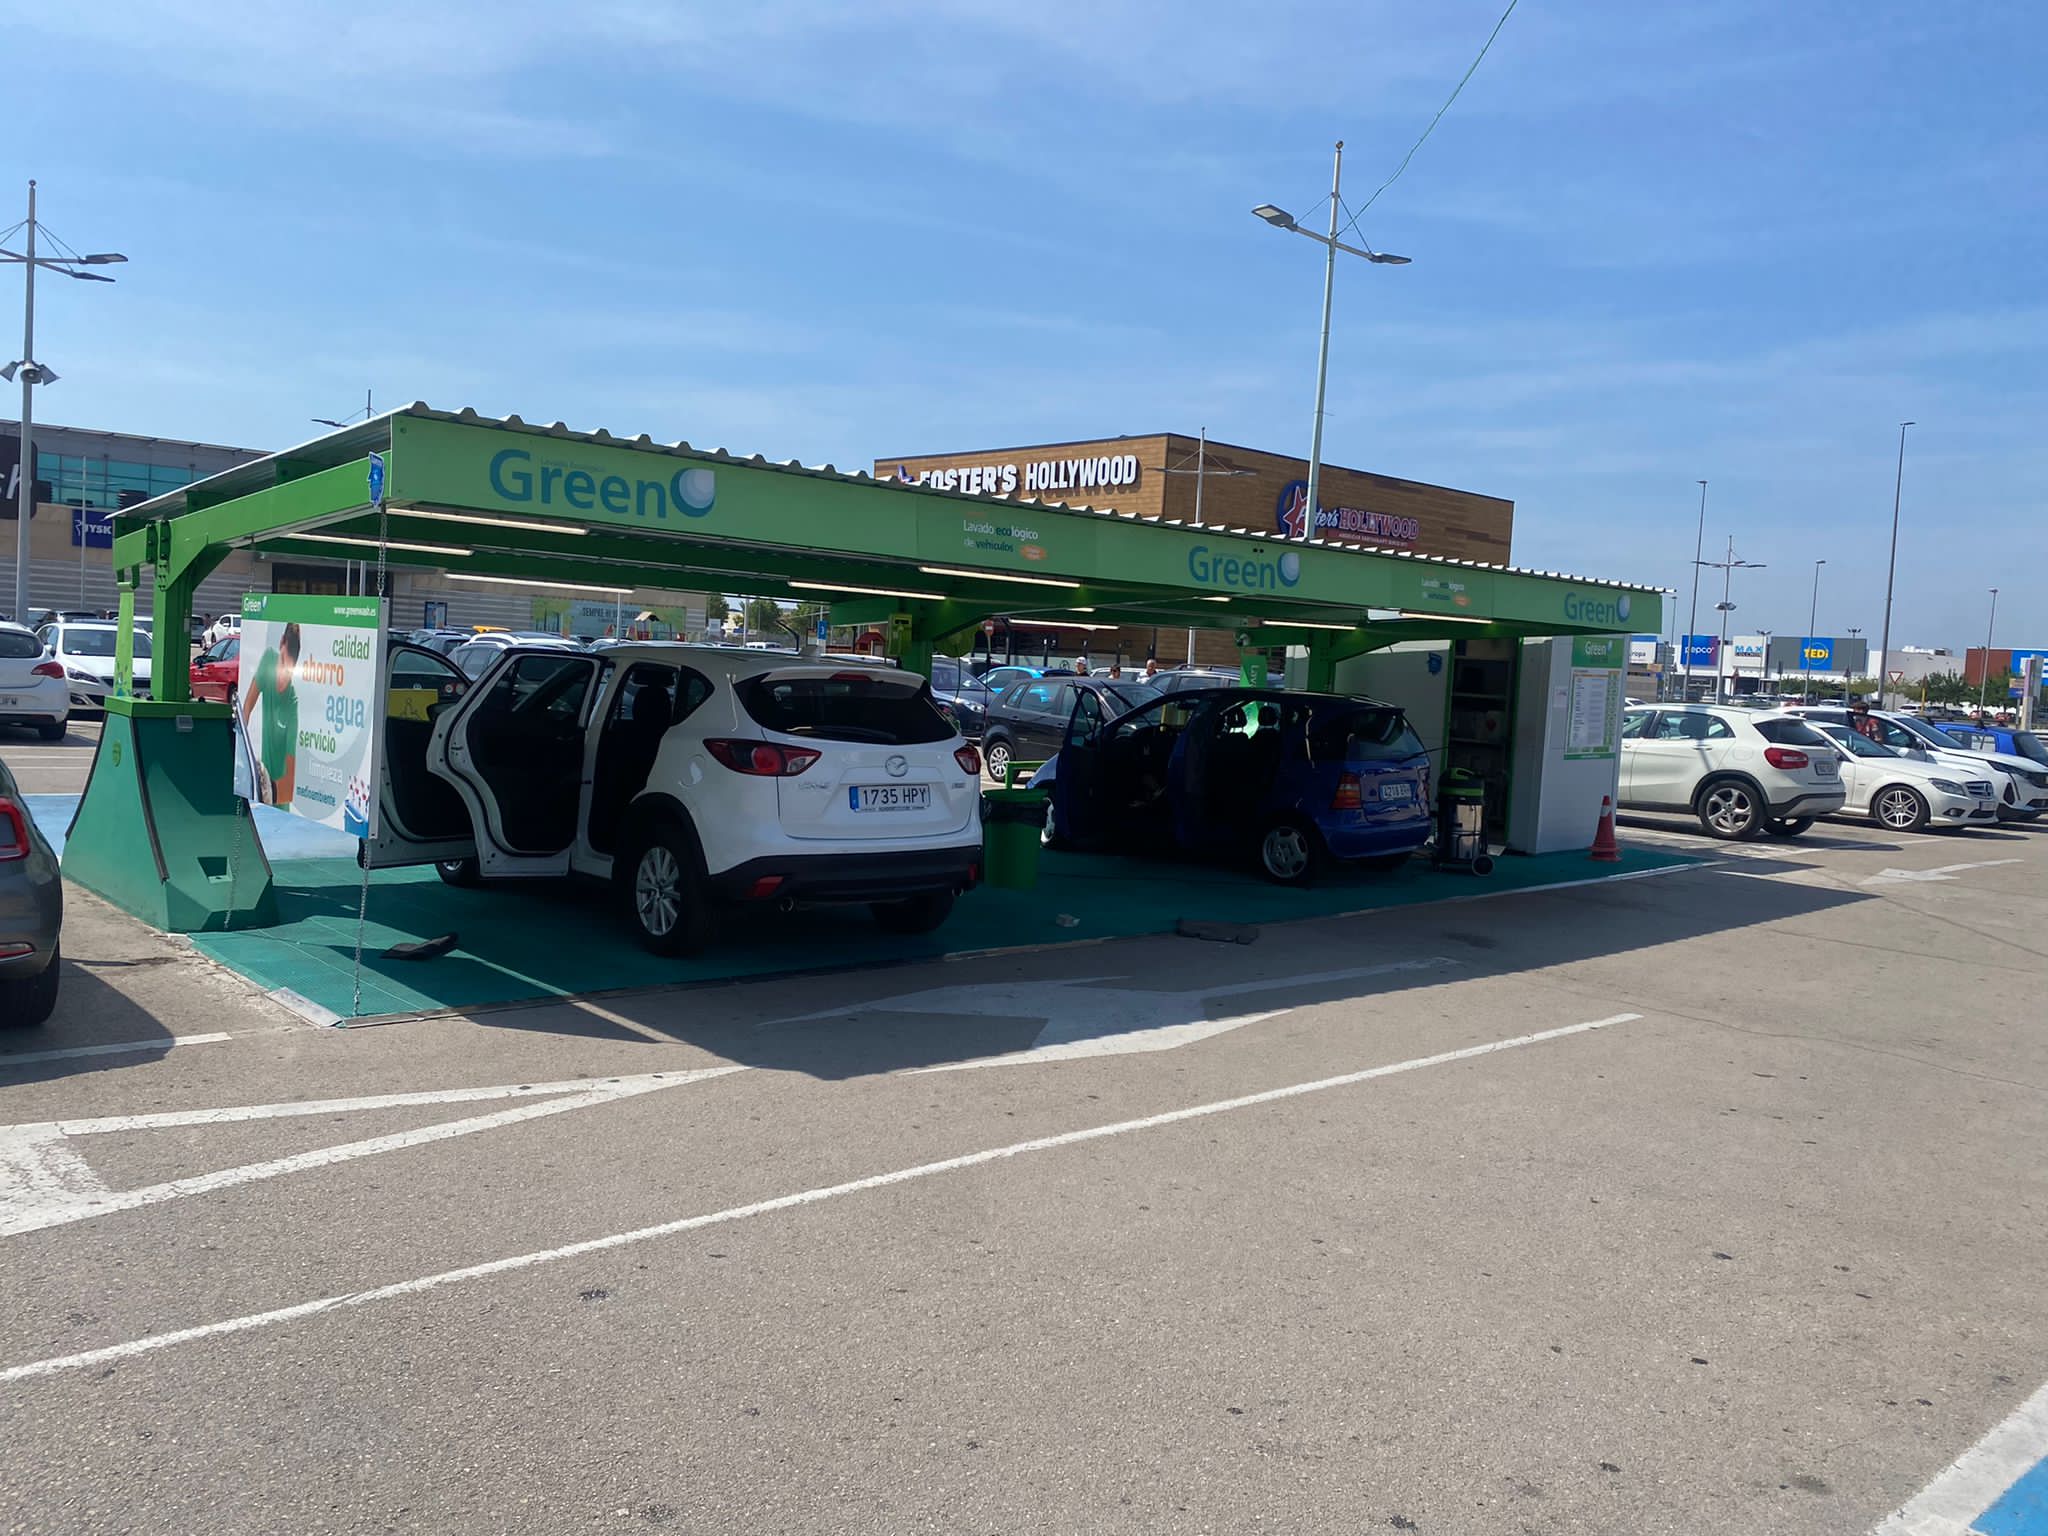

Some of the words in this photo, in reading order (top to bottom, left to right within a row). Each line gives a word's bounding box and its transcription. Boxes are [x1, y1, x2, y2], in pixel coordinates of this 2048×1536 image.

[1025, 455, 1137, 490] HOLLYWOOD
[963, 519, 994, 535] Lavado
[1338, 508, 1418, 540] HOLLYWOOD
[1188, 546, 1276, 589] Green
[243, 597, 262, 612] Green
[1564, 592, 1615, 625] Green
[332, 634, 370, 660] calidad
[1630, 651, 1647, 659] ropa
[1684, 646, 1713, 655] pepco
[1734, 645, 1763, 654] MAX
[302, 654, 344, 687] ahorro
[326, 695, 365, 733] agua
[299, 728, 336, 753] servicio
[863, 788, 898, 805] 1735
[903, 786, 926, 803] HPY
